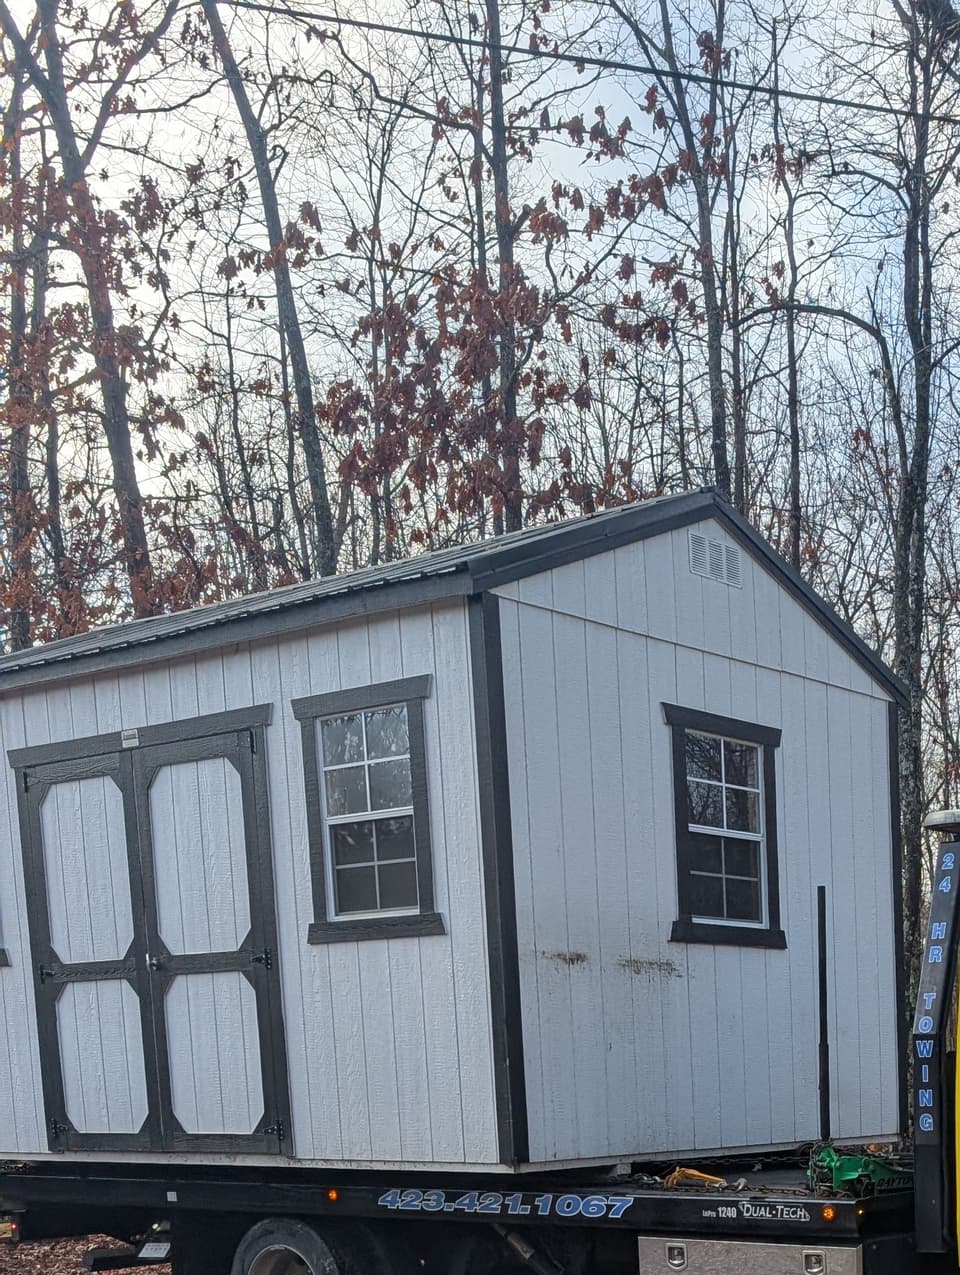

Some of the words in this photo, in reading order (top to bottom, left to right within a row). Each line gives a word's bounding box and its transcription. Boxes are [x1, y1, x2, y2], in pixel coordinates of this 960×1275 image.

[939, 852, 954, 893] 24
[929, 921, 946, 963] HR
[916, 992, 936, 1131] TOWING
[377, 1189, 634, 1218] 423.421.1067
[717, 1206, 737, 1218] 1240
